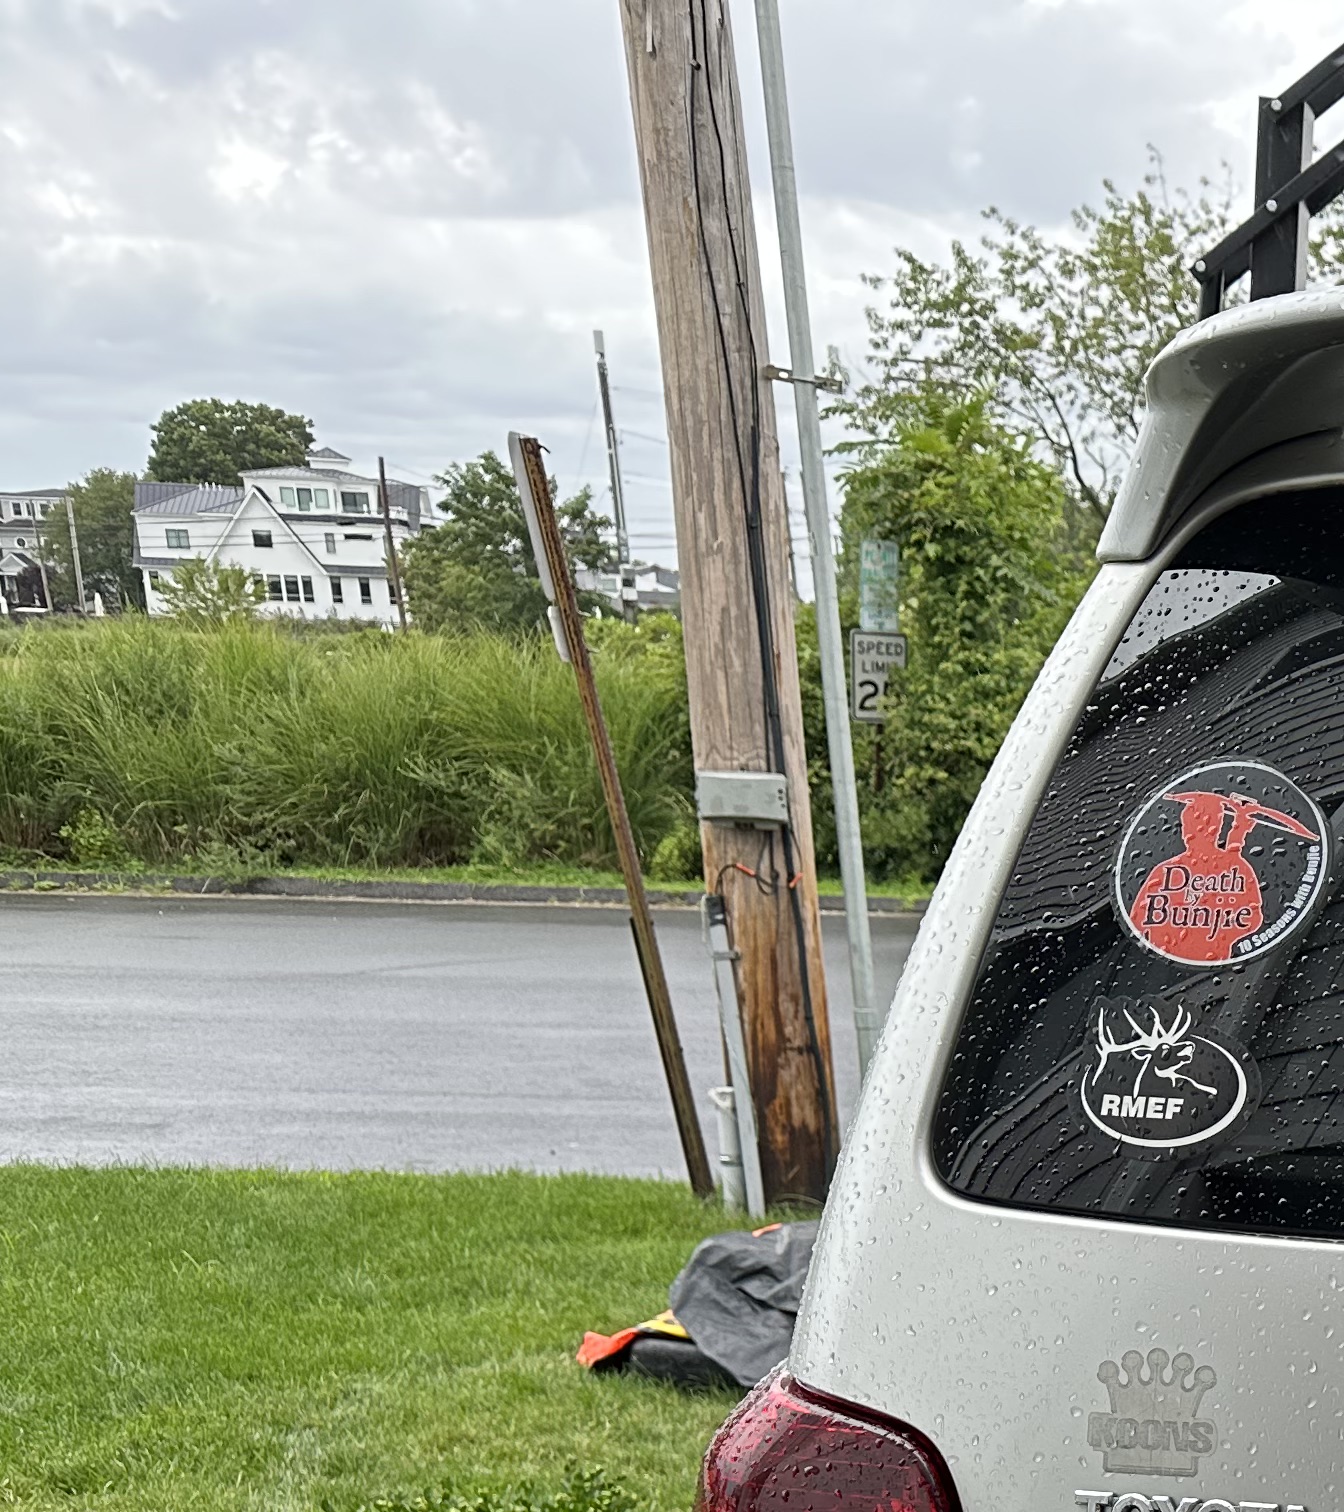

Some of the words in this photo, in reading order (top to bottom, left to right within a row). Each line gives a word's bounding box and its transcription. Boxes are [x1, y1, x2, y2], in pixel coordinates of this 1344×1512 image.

[857, 640, 903, 656] SPEED
[861, 660, 892, 674] LIMI
[1160, 865, 1245, 893] Death
[1185, 887, 1203, 906] by
[1142, 894, 1253, 941] Bunjie
[1237, 939, 1253, 954] 10
[1251, 907, 1297, 947] Seasons
[1291, 883, 1313, 909] with
[1100, 1093, 1185, 1120] RMEF
